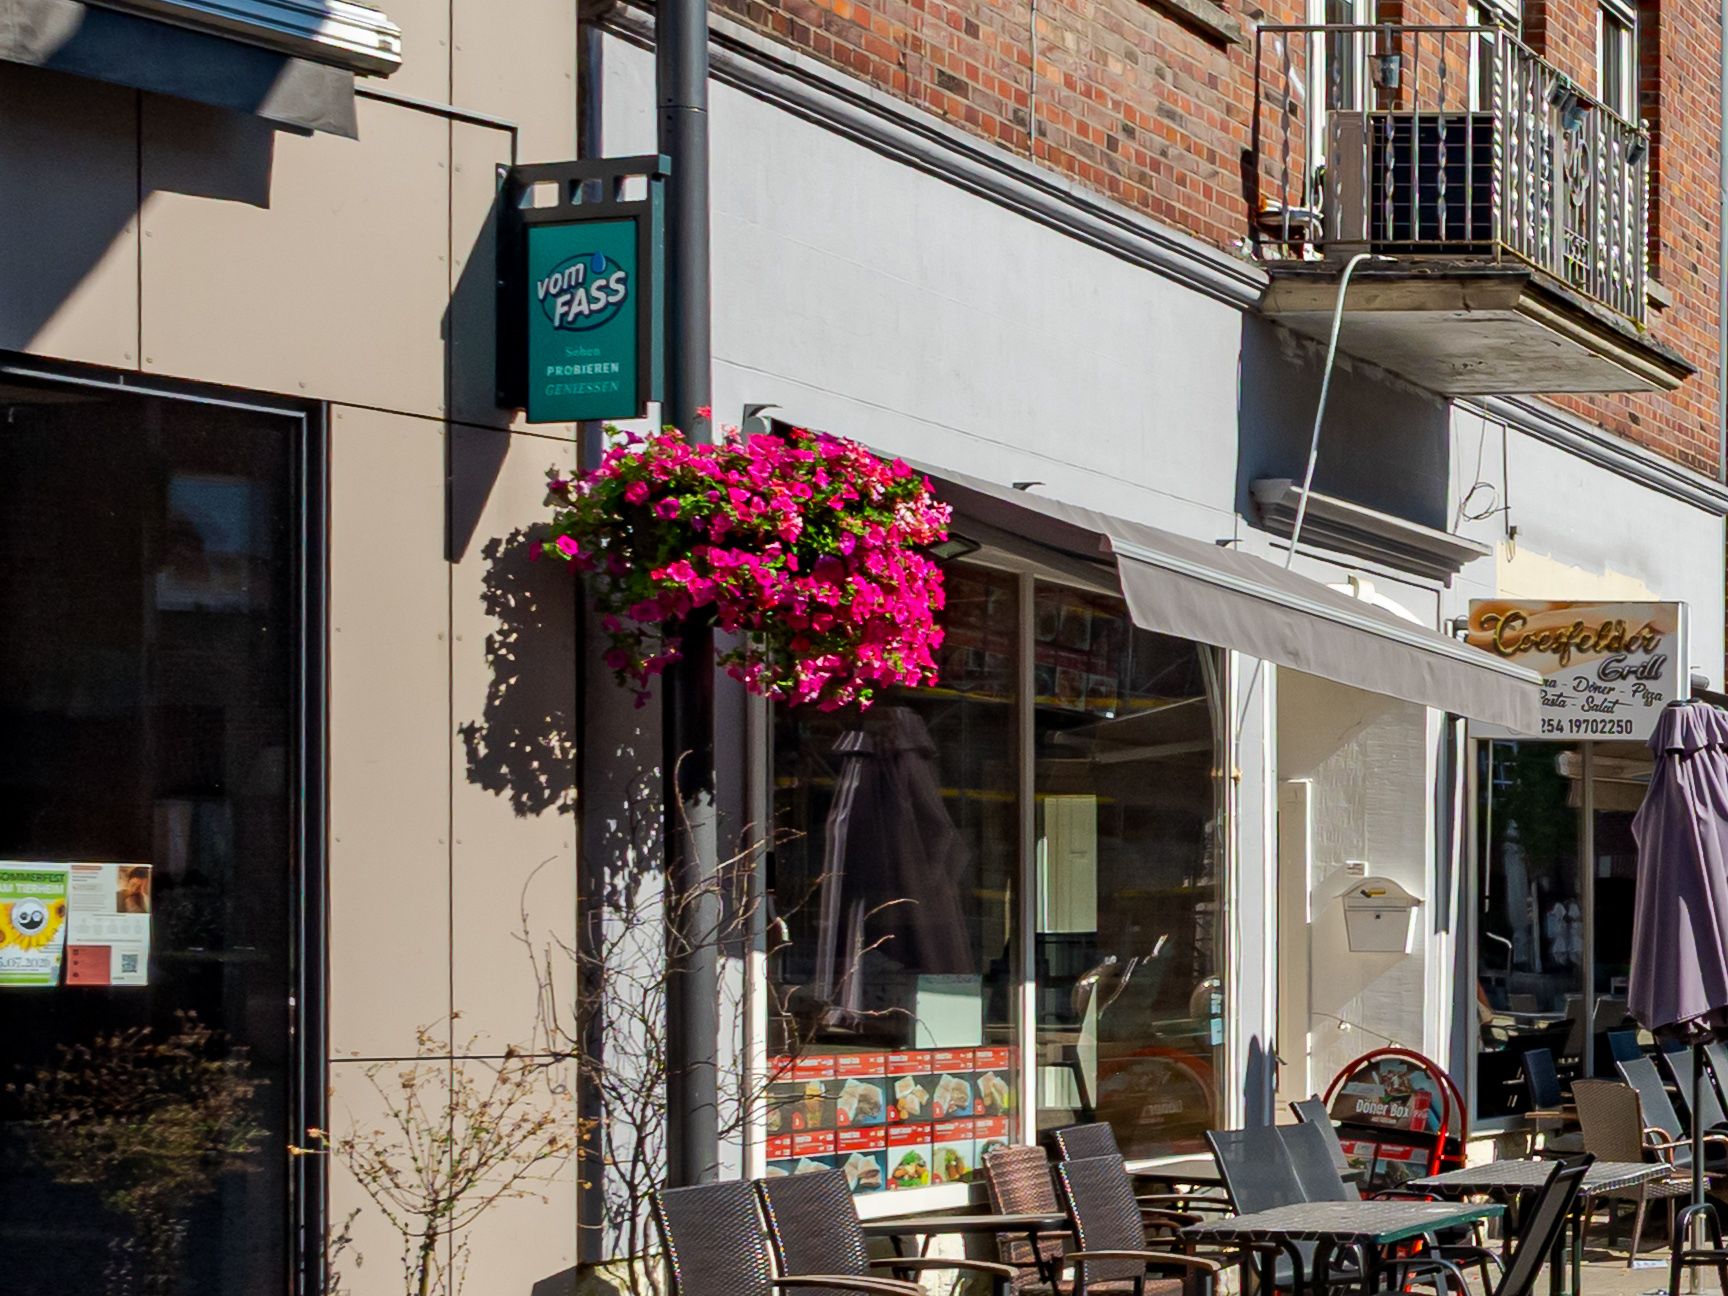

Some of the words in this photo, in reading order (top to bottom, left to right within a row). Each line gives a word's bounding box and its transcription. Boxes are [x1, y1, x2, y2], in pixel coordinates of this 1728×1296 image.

[537, 263, 585, 301] vom
[553, 270, 627, 327] FASS
[546, 362, 620, 376] PROBIEREN
[545, 381, 620, 396] GENIESSEN
[1479, 609, 1662, 667] Coesfelder
[1597, 654, 1668, 682] Grill
[1572, 676, 1615, 695] Döner
[1631, 682, 1664, 707] Pizza
[1568, 719, 1633, 734] 19702250
[0, 871, 66, 883] OMMERFEST
[1355, 1098, 1389, 1116] Döner
[1390, 1103, 1409, 1118] Box
